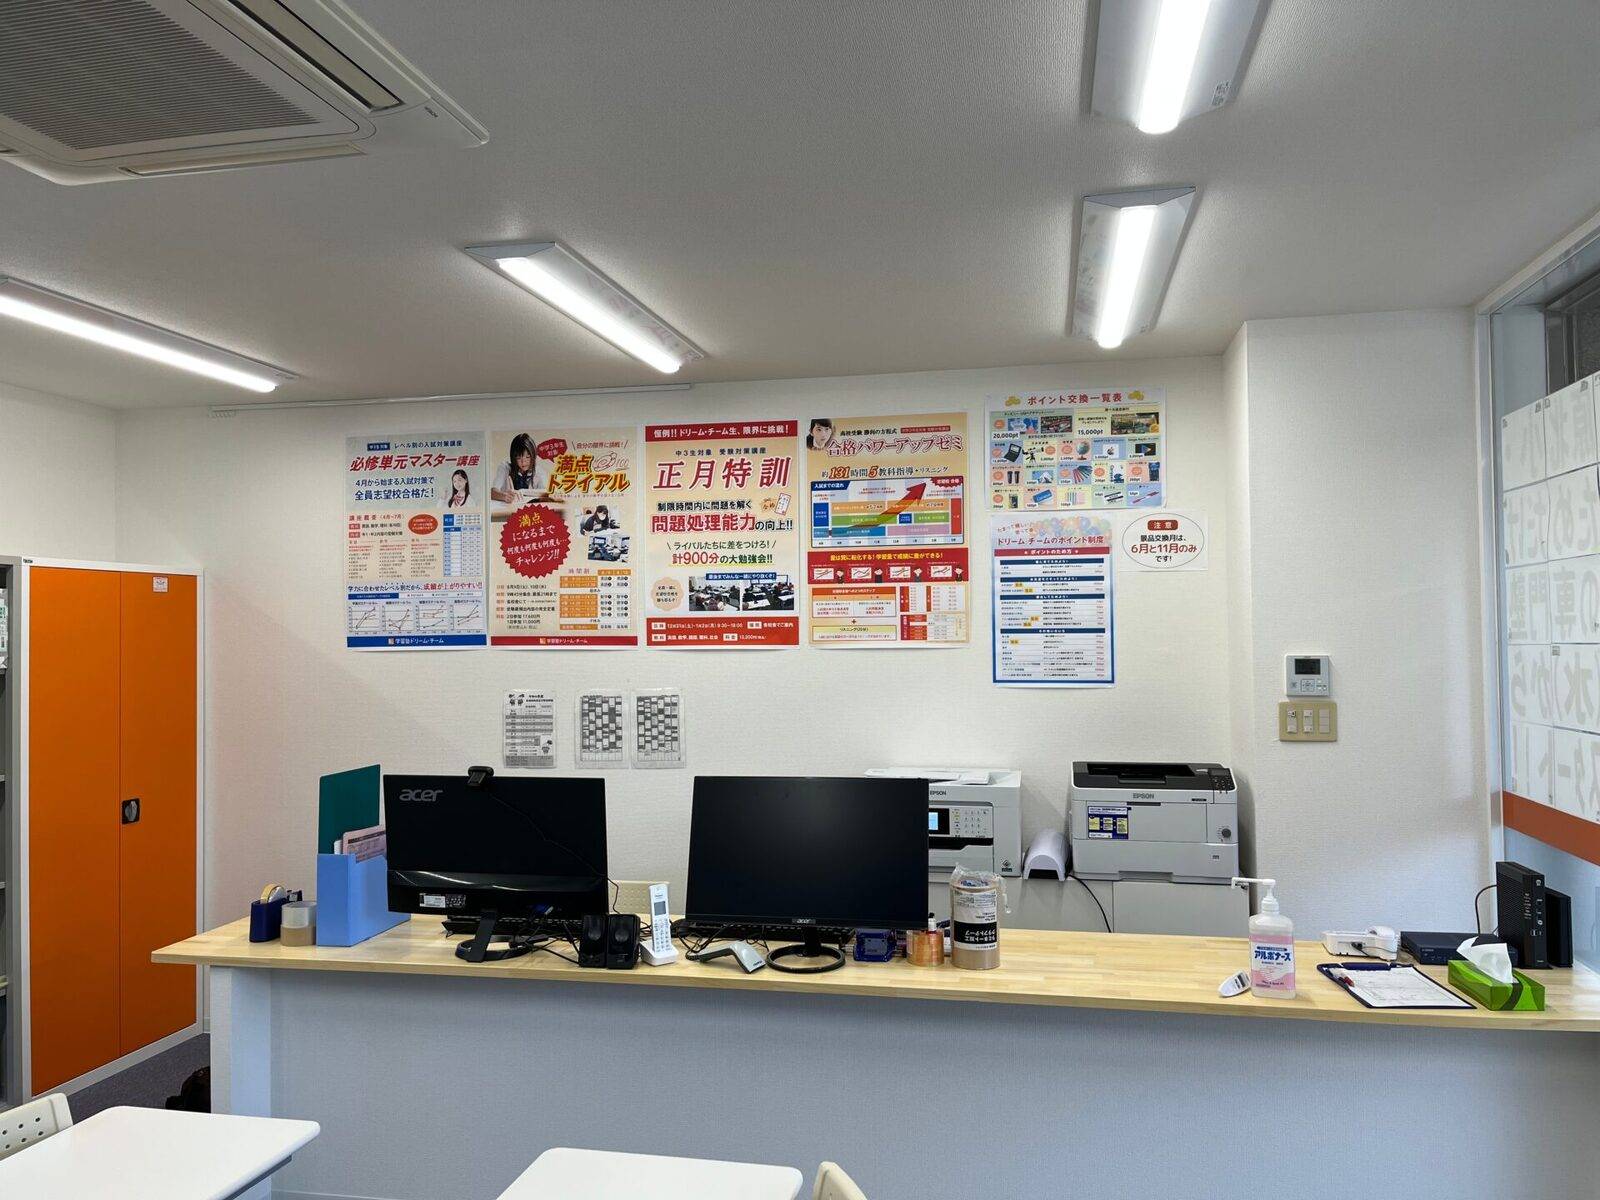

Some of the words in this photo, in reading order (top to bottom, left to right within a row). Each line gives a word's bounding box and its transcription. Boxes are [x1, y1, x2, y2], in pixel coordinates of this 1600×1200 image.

[1028, 393, 1123, 406] ポイント交換一覧表
[675, 449, 712, 457] 中3生対象
[719, 447, 767, 456] 受験対策講座
[827, 434, 963, 457] 合格パワーアップゼミ
[349, 453, 480, 472] 必修単元マスター講座
[556, 454, 593, 473] 満点
[652, 457, 792, 491] 正月特訓
[355, 476, 434, 487] 4月から始まる入試対策で
[547, 474, 631, 495] トライアル
[658, 501, 752, 512] 制限時間内に問題を解く
[518, 513, 543, 527] 満点
[513, 525, 556, 542] になるまで
[1140, 534, 1186, 542] 景品交換月は、
[1130, 542, 1198, 554] 6月と11月のみ
[399, 788, 444, 802] acer
[1254, 950, 1292, 962] アルボナース
